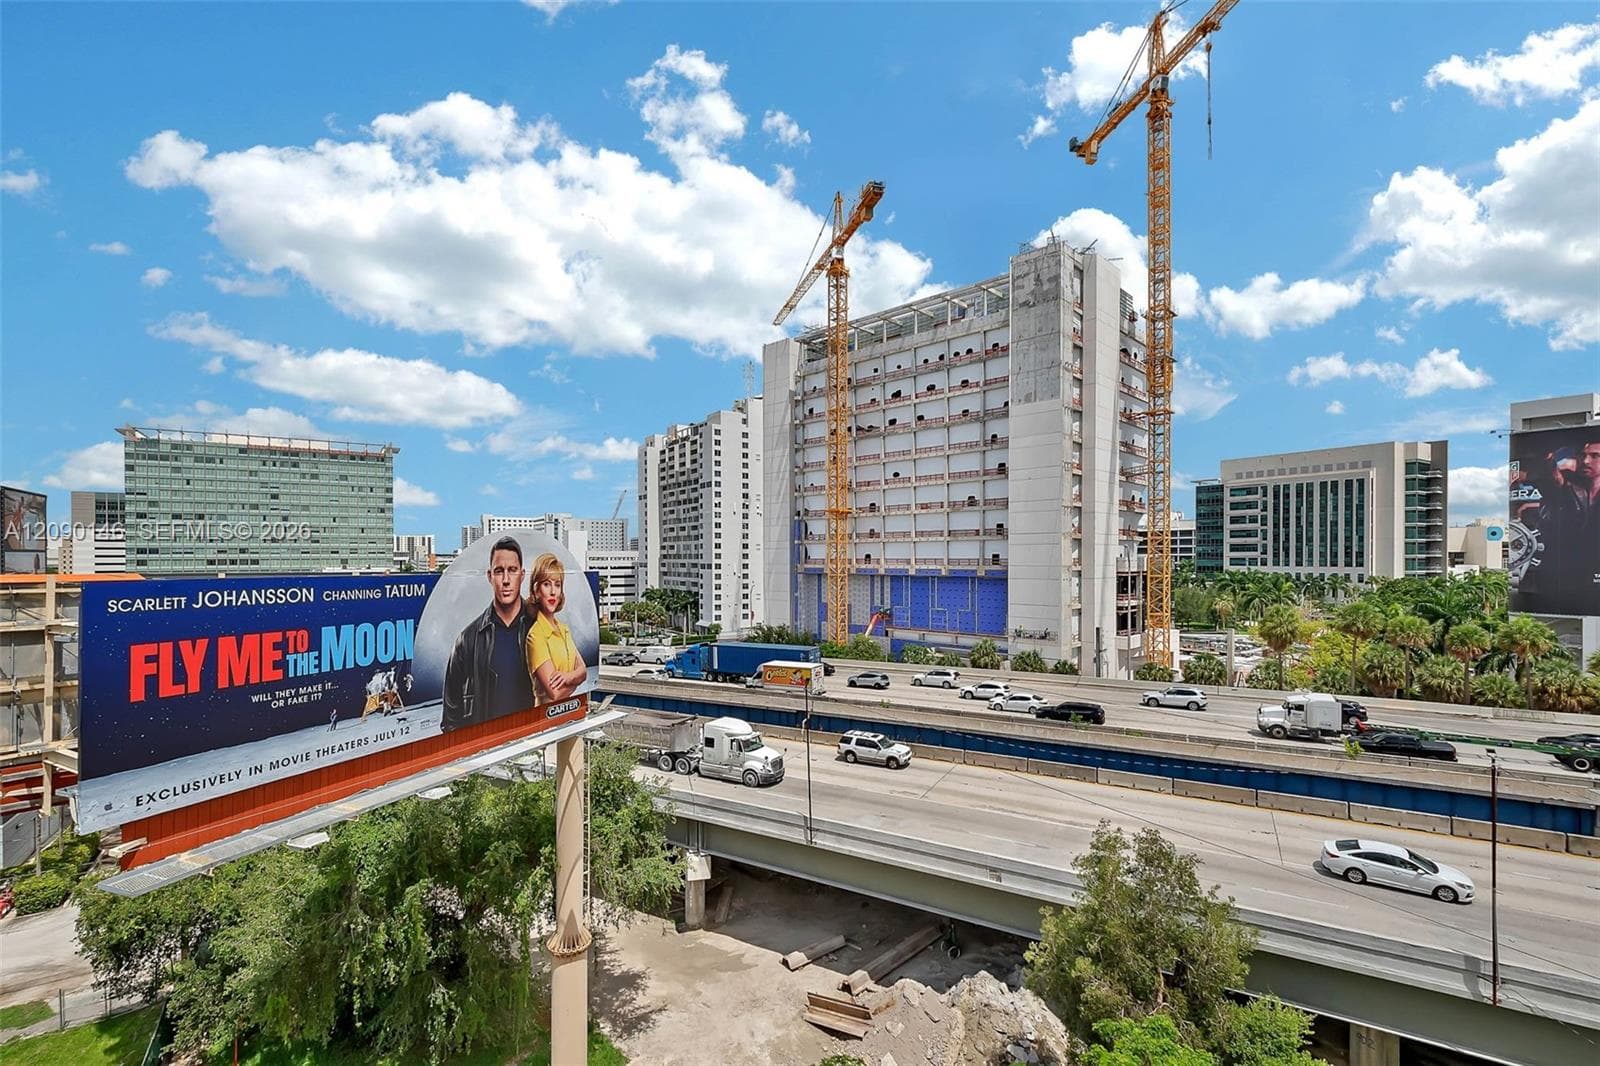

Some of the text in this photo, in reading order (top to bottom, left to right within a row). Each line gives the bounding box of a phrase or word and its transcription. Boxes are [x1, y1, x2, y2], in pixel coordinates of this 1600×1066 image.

[107, 584, 426, 613] SCARLETT JOHANSSON CHANNING TATUM
[130, 618, 415, 704] FLY ME TO THE MOON
[251, 692, 272, 703] WILL
[275, 688, 296, 699] THEY
[299, 684, 323, 695] MAKE
[271, 692, 322, 709] OR FAKE IT?
[548, 699, 578, 716] CARTER
[135, 726, 410, 807] EXCLUSIVELY IN MOVIE THEATERS JULY 12
